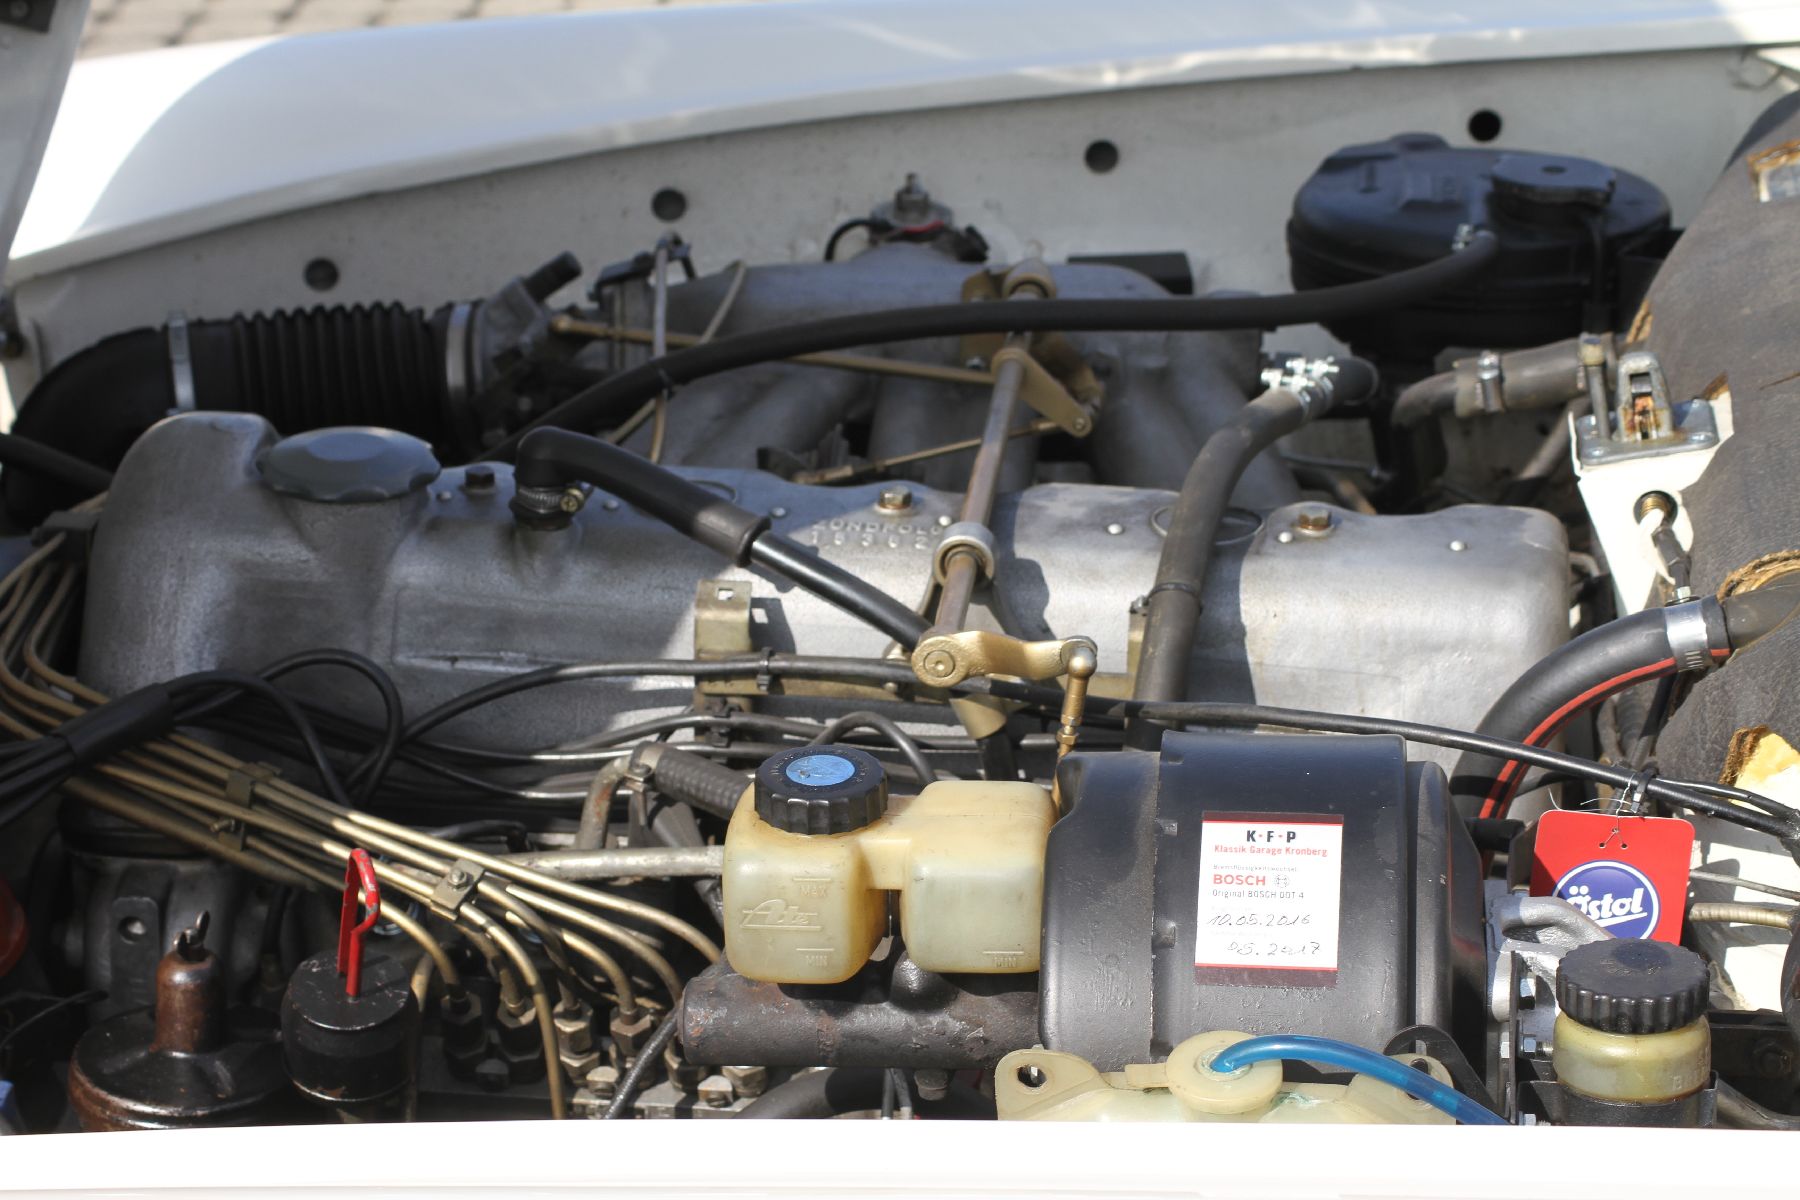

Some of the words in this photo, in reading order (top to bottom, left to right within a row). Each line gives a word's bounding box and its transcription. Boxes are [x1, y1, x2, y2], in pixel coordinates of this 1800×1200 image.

[1214, 844, 1247, 854] Klassik
[1249, 846, 1282, 856] Garage
[1285, 847, 1328, 858] Kronberg
[1213, 874, 1266, 886] BOSCH
[1212, 889, 1245, 899] Original
[1247, 890, 1277, 899] BOSCH
[1279, 890, 1296, 899] DOT
[1298, 891, 1304, 899] 4
[1207, 914, 1311, 927] 10.05.2016
